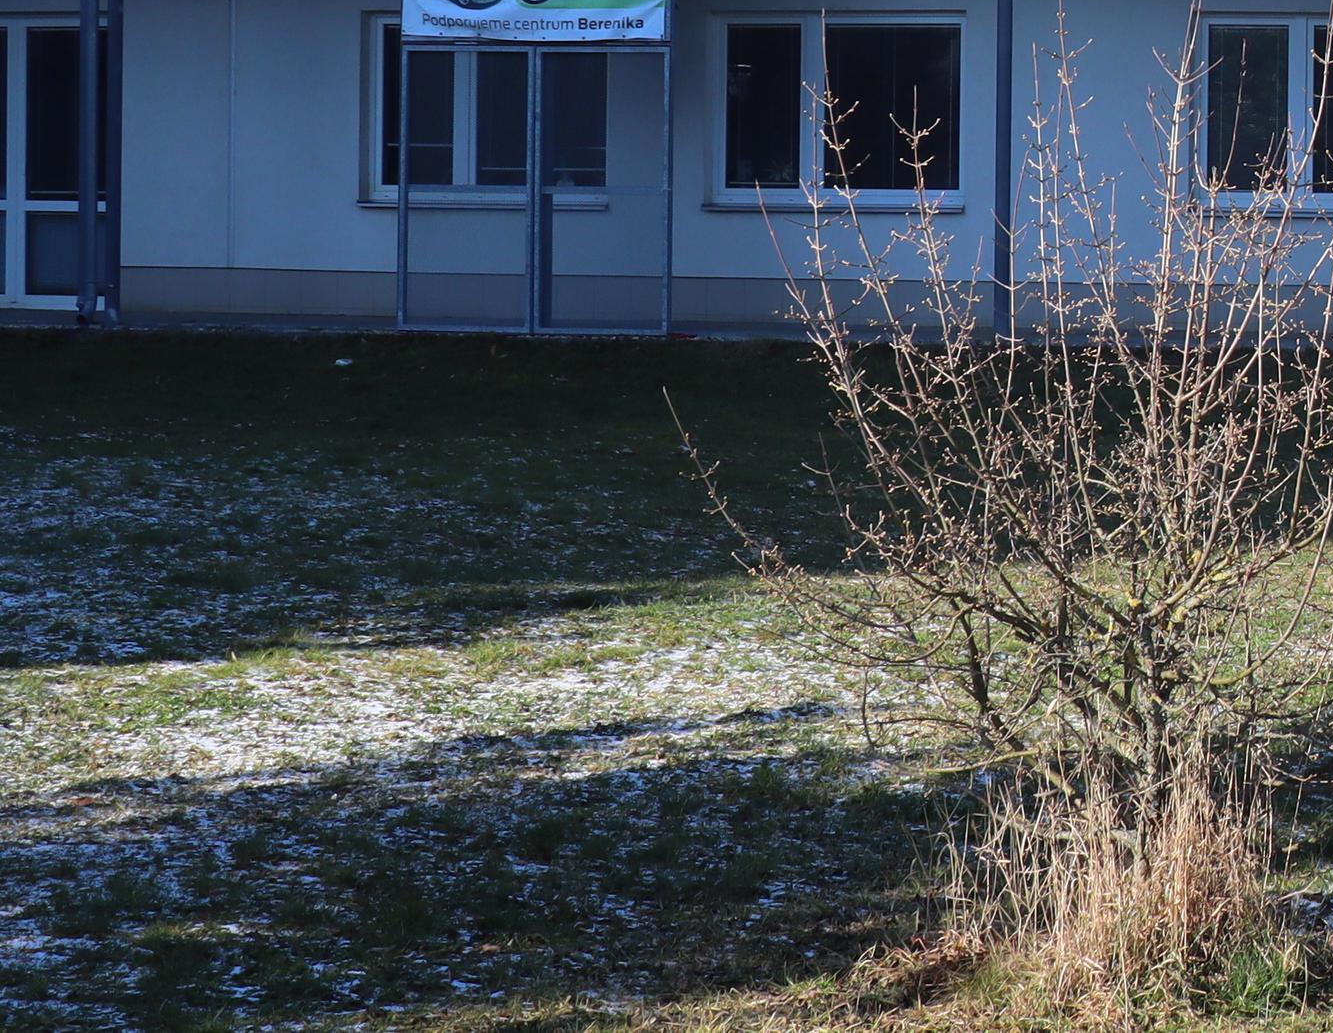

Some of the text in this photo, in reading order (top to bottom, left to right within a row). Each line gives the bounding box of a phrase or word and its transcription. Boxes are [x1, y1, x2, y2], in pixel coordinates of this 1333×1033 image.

[423, 14, 643, 30] Podporujeme centrum Berenika
